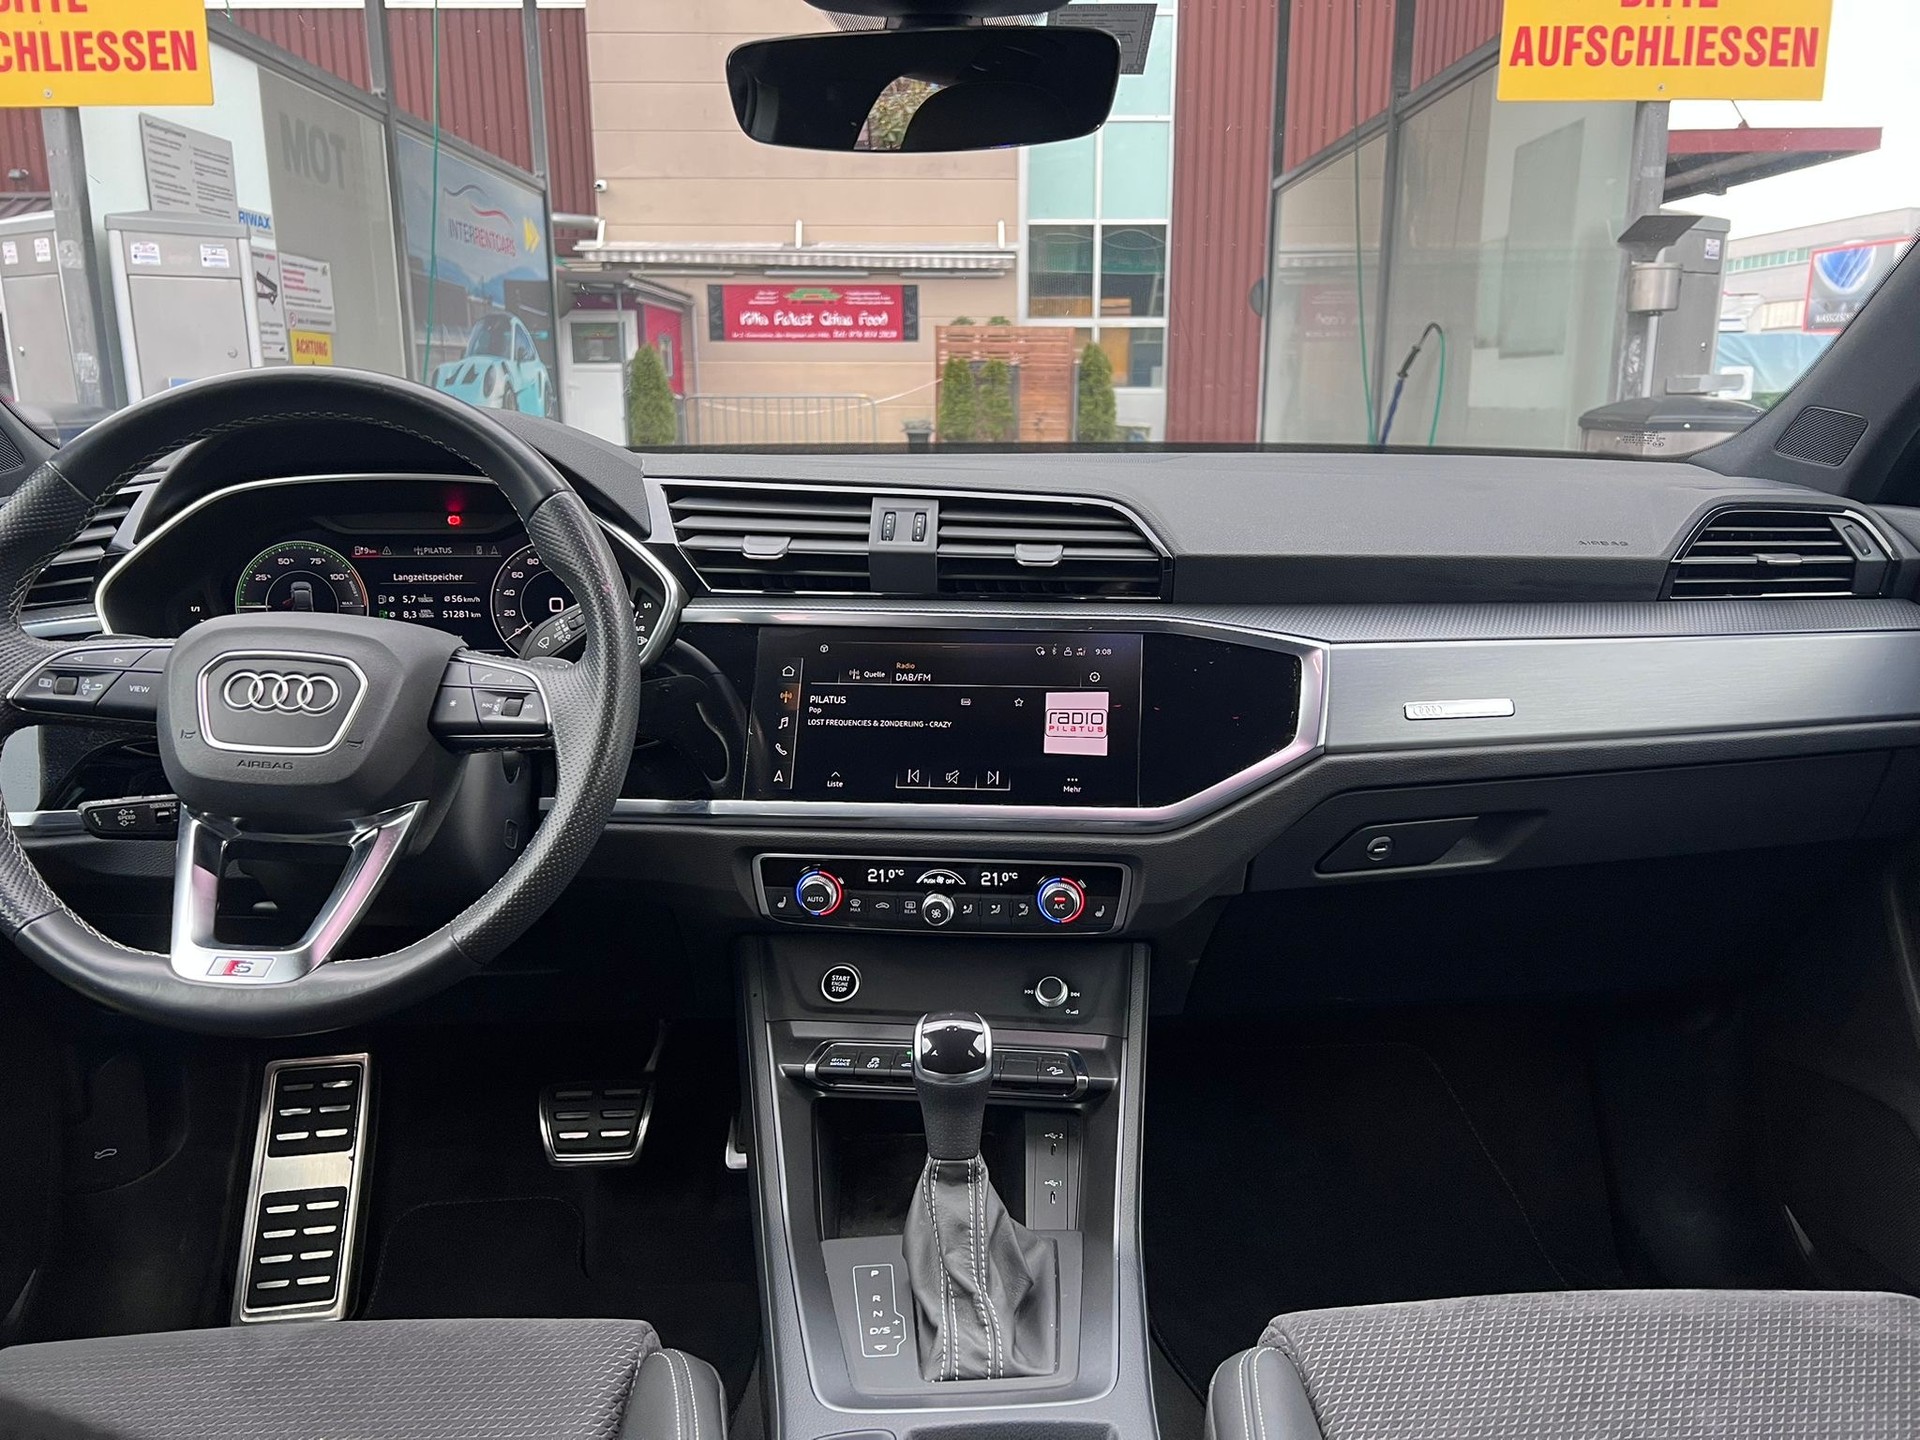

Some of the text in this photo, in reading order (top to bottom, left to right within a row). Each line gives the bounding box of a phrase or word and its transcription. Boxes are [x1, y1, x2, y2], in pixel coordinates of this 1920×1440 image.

[1509, 25, 1819, 67] AUFSCHLIESSEN
[296, 339, 328, 357] ACHTUNG
[393, 573, 464, 582] Langzeitspeicher
[511, 571, 524, 579] 60
[895, 673, 931, 682] DAB/FM
[129, 685, 150, 693] VIEW
[809, 695, 847, 704] PILATUS
[808, 706, 822, 714] Pop
[825, 719, 872, 727] FREQUENCIES
[880, 720, 924, 728] ZONDERLING
[237, 760, 294, 770] AIRBAG
[827, 780, 844, 788] Liste
[1063, 785, 1082, 793] Mehr
[870, 1326, 891, 1335] D/S
